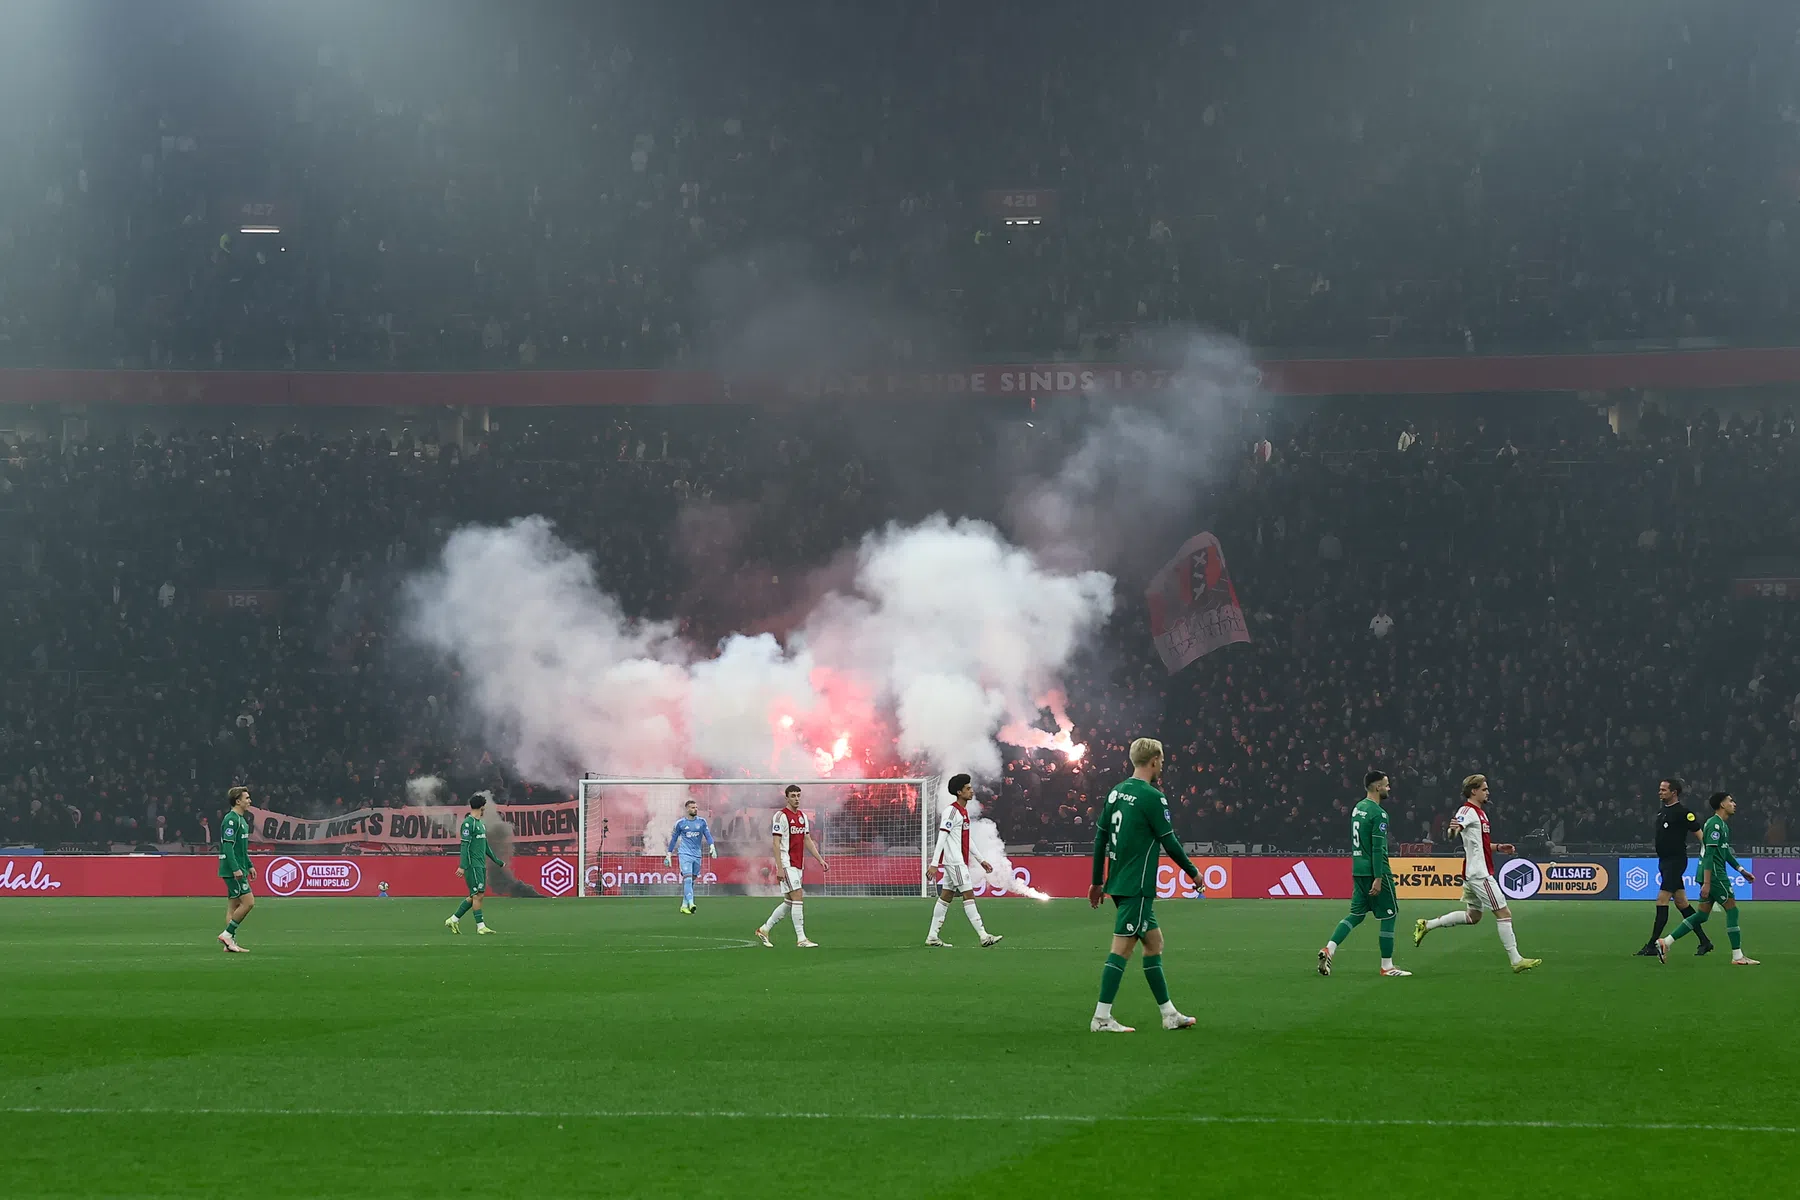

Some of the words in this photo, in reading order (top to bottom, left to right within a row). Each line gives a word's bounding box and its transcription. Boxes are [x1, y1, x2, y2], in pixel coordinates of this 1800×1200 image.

[1000, 371, 1095, 391] SINDS
[1114, 370, 1180, 389] 197
[263, 817, 321, 840] GAAT
[326, 812, 384, 837] NIETS
[390, 814, 457, 839] BOVEN
[311, 866, 345, 876] ALLSAFE
[585, 865, 717, 888] Coinmee
[1550, 867, 1592, 879] ALLSAFE
[306, 879, 322, 887] MINI
[322, 879, 350, 887] OPSLAG
[1392, 874, 1464, 887] CKSTARS
[1545, 881, 1563, 891] MINI
[1565, 881, 1598, 891] OPSLAG
